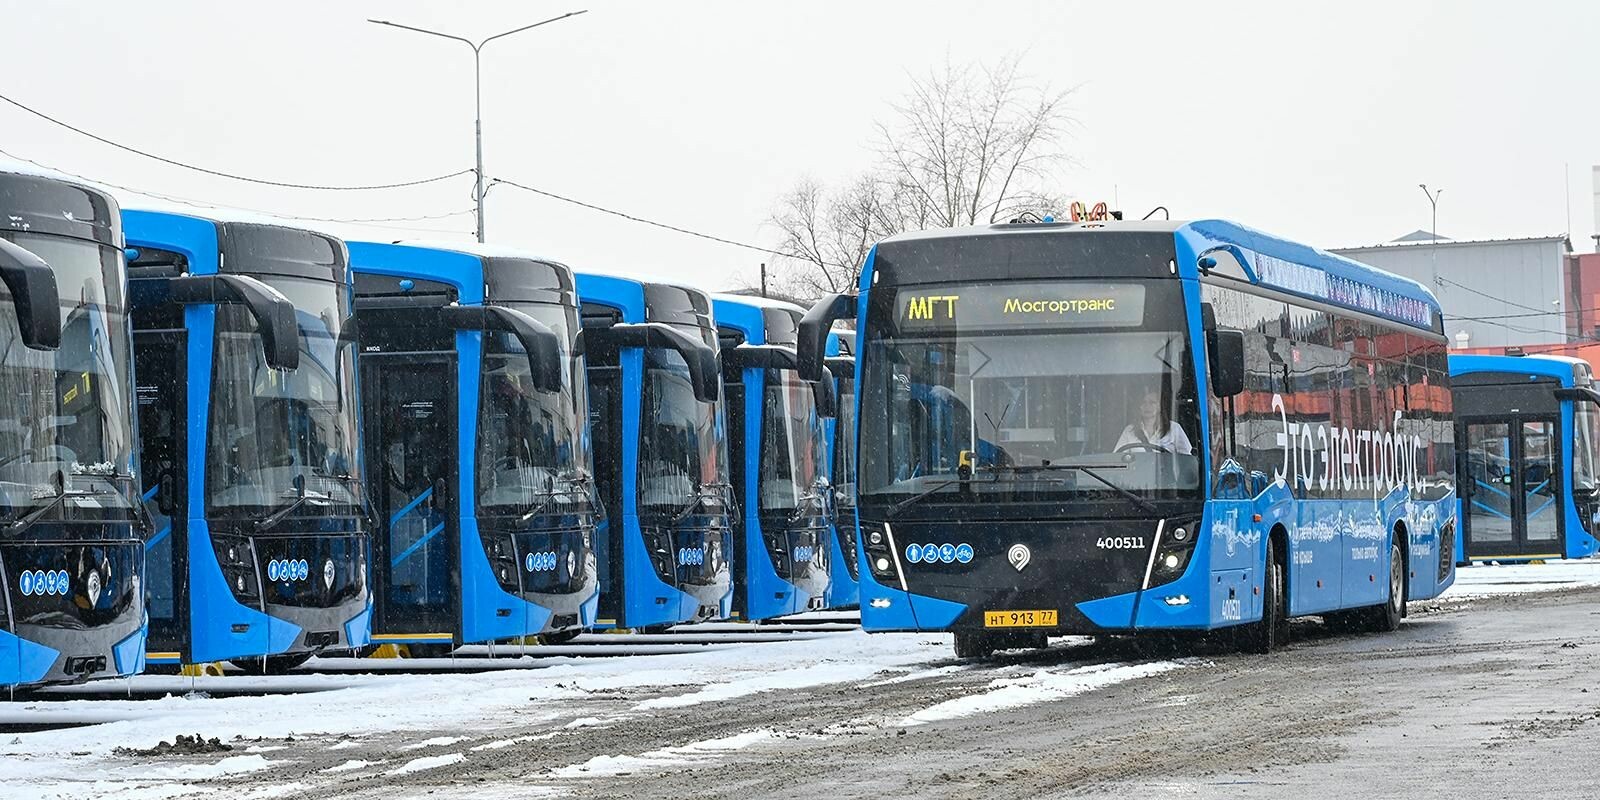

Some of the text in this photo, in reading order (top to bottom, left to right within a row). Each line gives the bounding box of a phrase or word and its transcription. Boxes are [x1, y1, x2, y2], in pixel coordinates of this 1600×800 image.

[908, 295, 1115, 321] МГТ Мосгортранс
[1271, 393, 1314, 491] Это
[1096, 536, 1145, 550] 400511
[1010, 612, 1034, 625] 913
[1041, 611, 1053, 621] 77
